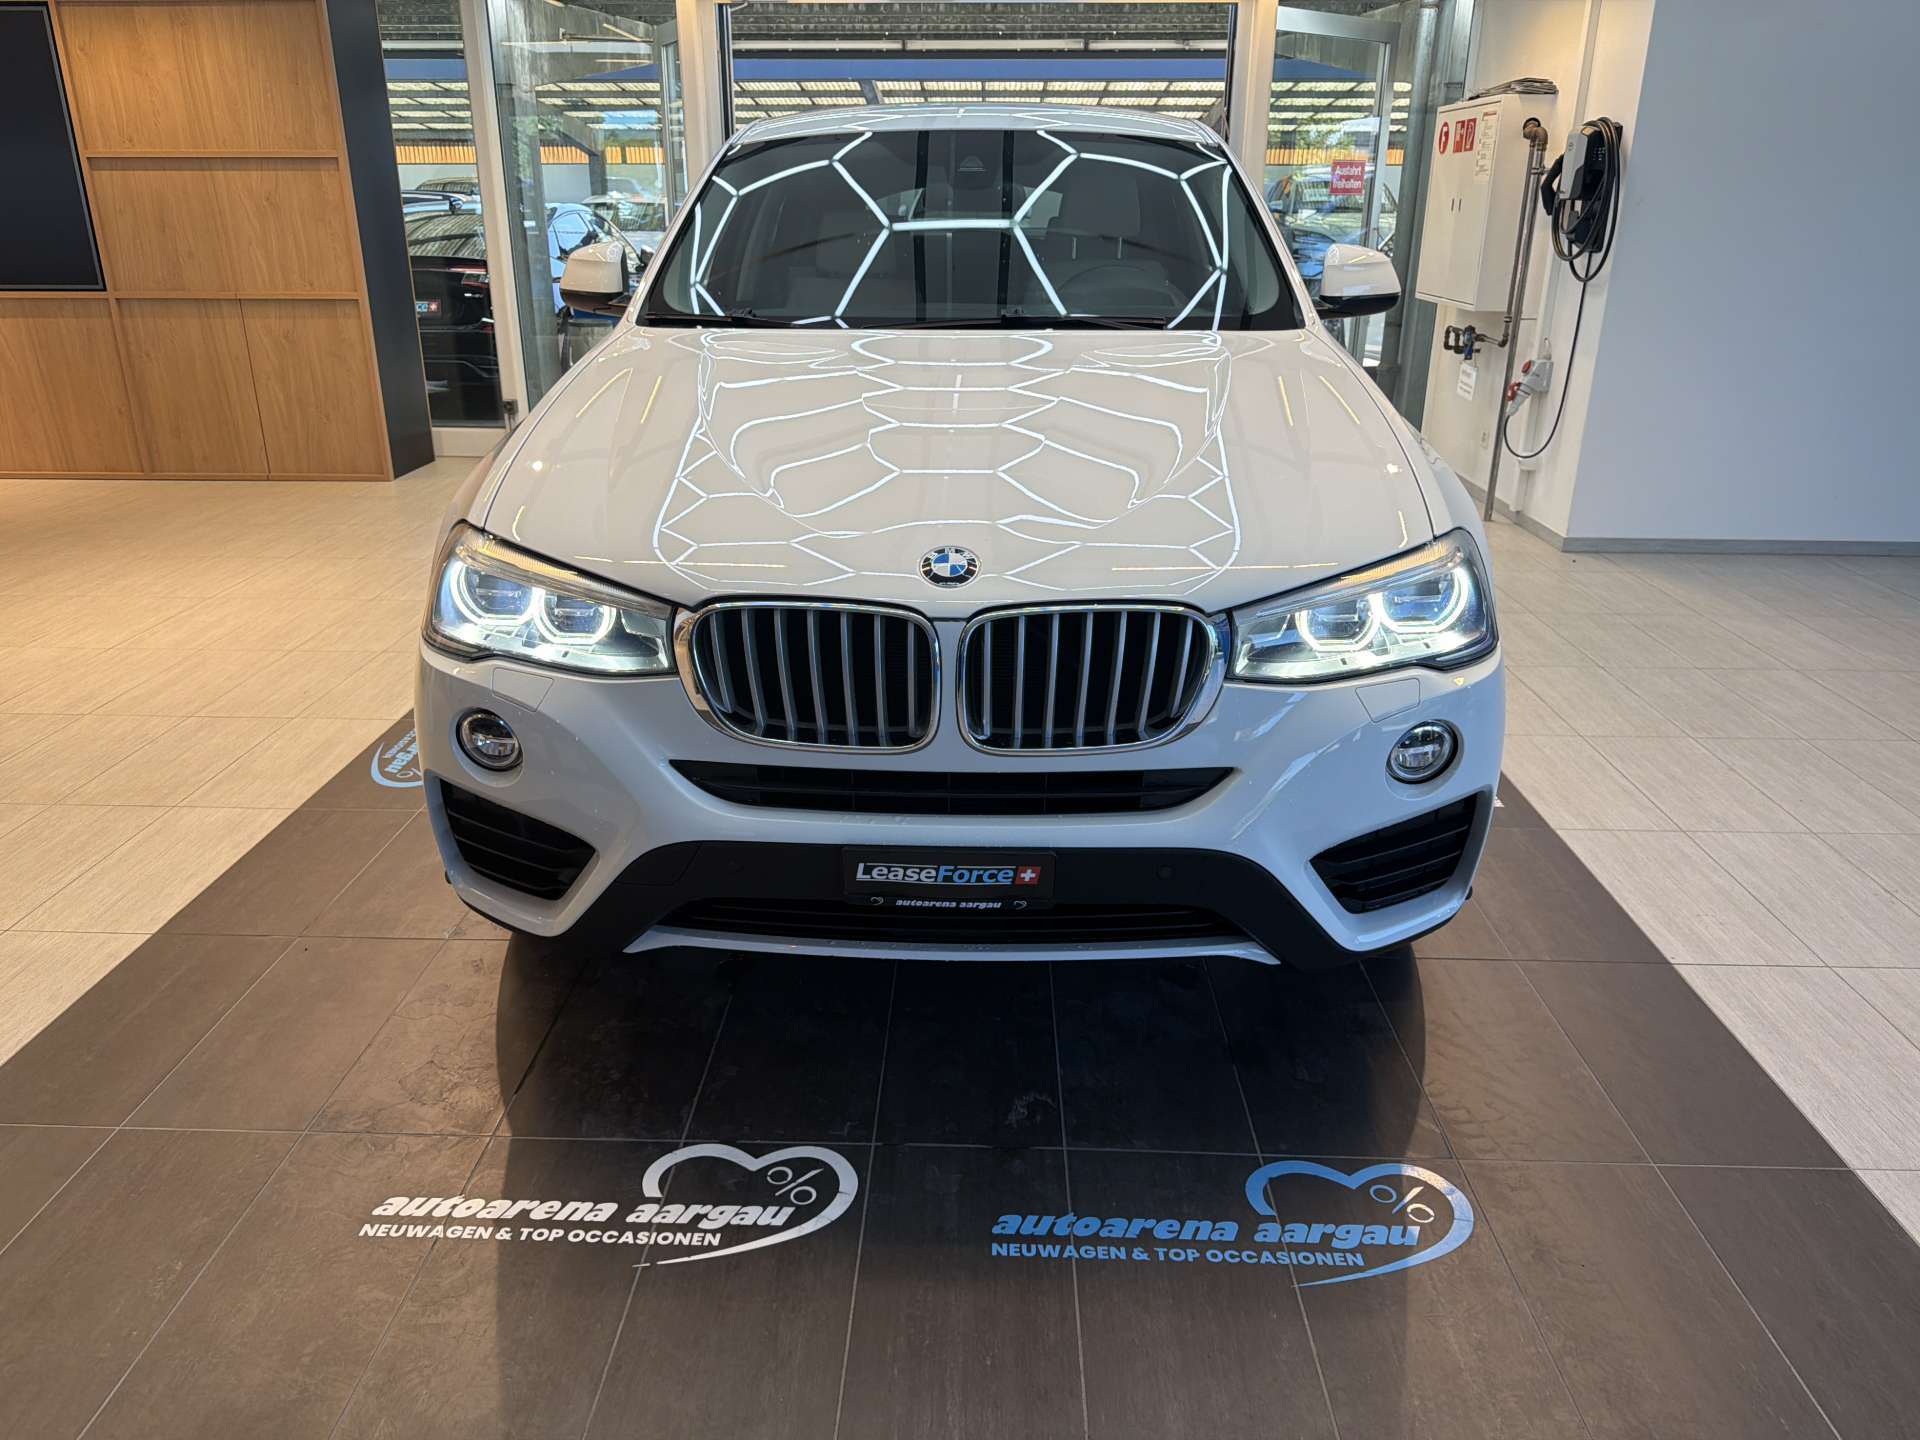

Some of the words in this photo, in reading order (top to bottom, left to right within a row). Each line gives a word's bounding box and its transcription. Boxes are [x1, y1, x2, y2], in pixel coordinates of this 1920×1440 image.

[856, 863, 1014, 883] LeaseForce
[896, 899, 957, 909] autoarena
[959, 900, 1002, 910] aargau
[371, 1195, 616, 1223] autoarena
[625, 1203, 796, 1229] aargau
[358, 1223, 493, 1242] NEUWAGEN
[494, 1229, 513, 1242] &
[519, 1228, 565, 1243] TOP
[567, 1230, 721, 1248] OCCASIONEN
[992, 1213, 1239, 1242] autoarena
[1253, 1221, 1421, 1250] aargau
[991, 1242, 1128, 1261] NEUWAGEN
[1132, 1246, 1152, 1262] &
[1156, 1247, 1201, 1262] TOP
[1205, 1249, 1366, 1268] OCCASIONEN
